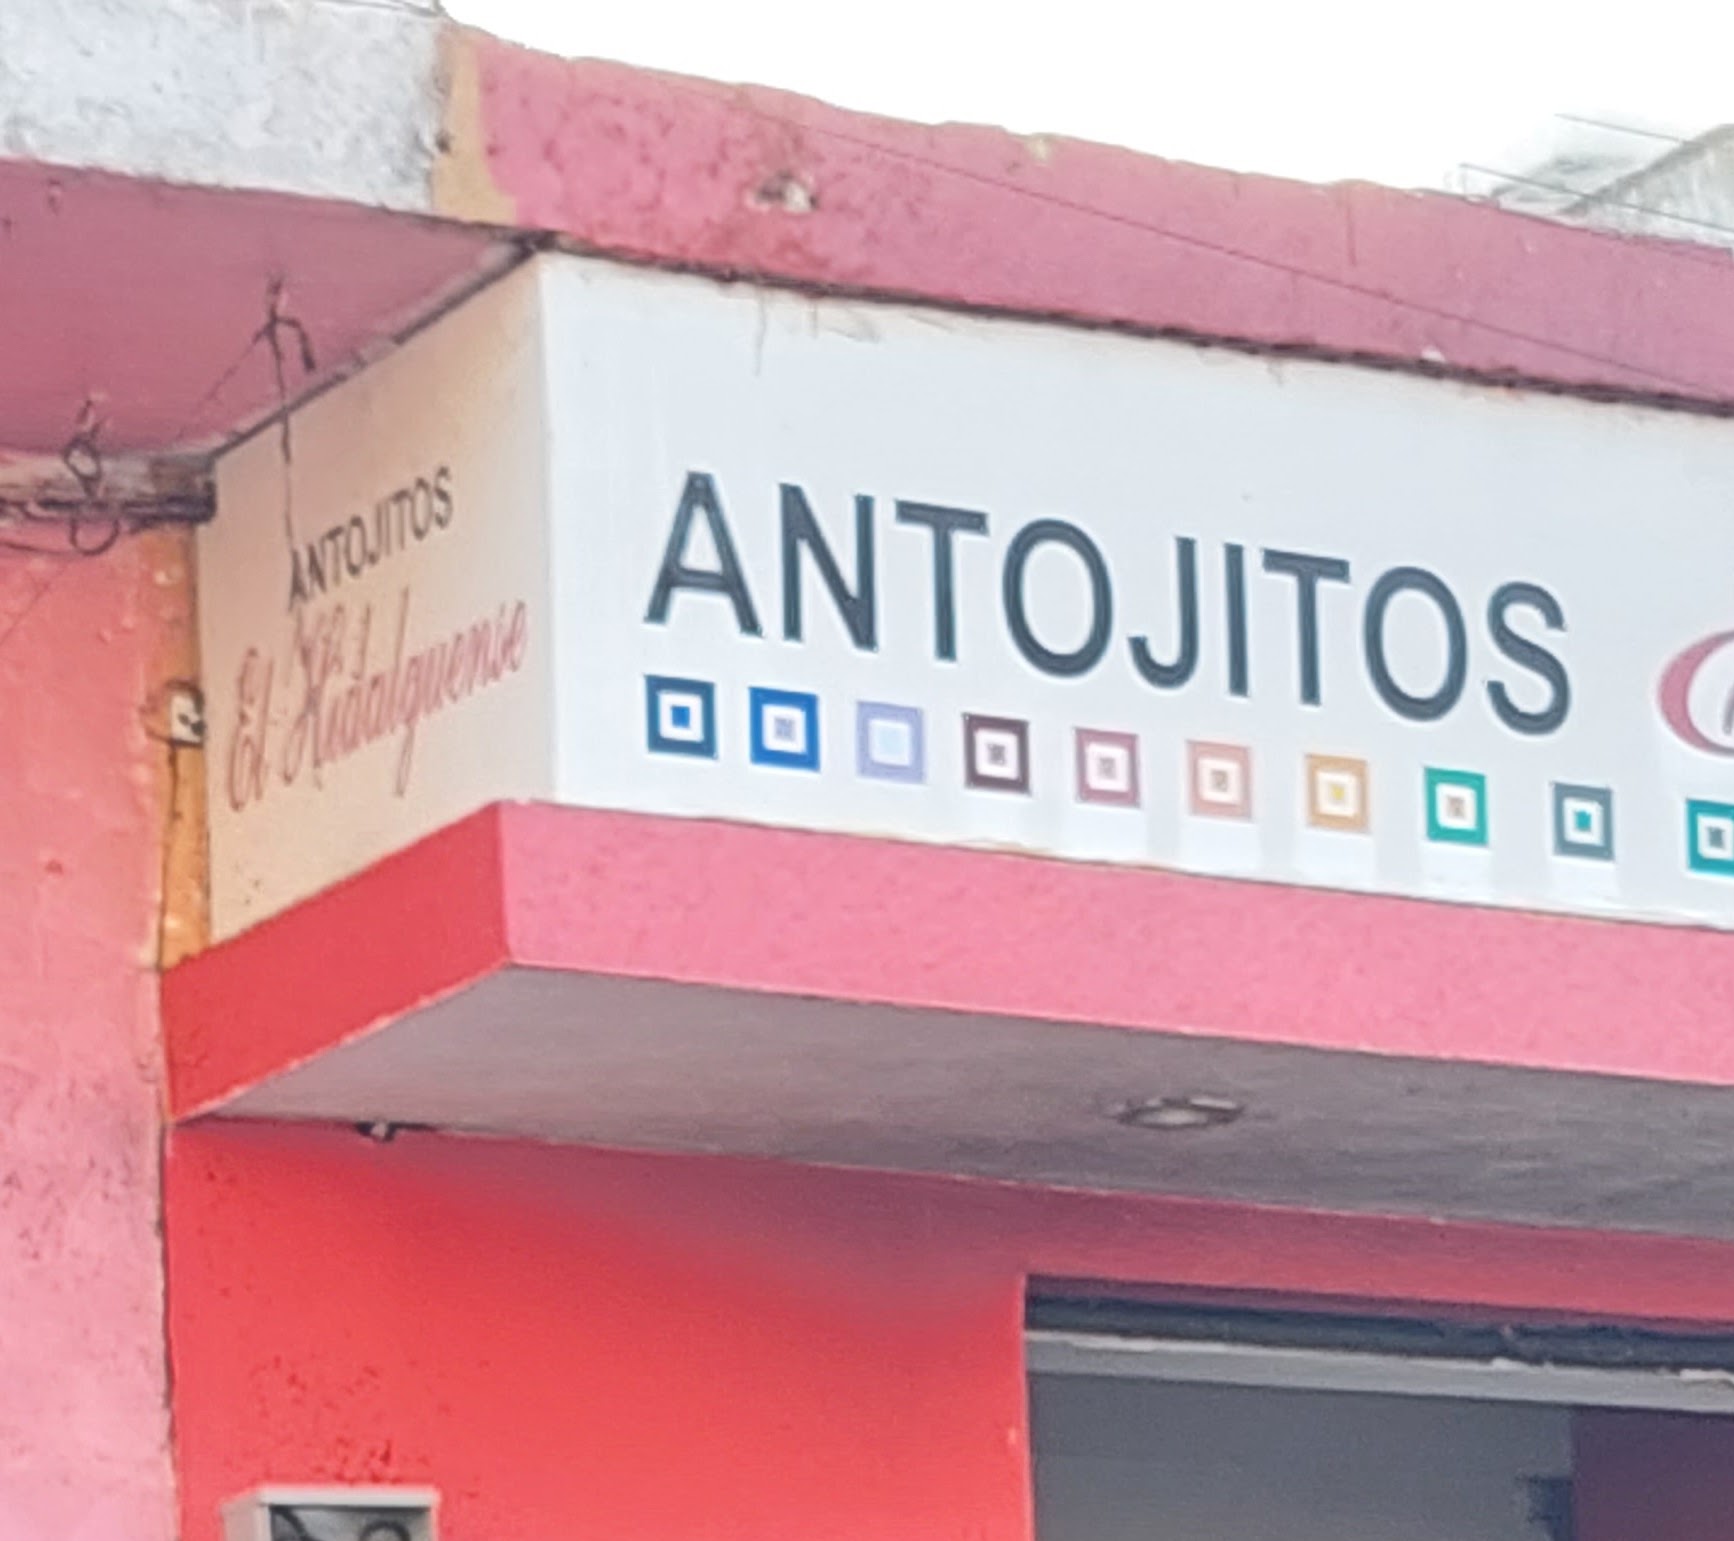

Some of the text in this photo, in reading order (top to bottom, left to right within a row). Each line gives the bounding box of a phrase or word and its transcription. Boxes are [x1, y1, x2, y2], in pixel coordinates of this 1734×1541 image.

[287, 466, 454, 612] ANTOJITOS
[643, 470, 1572, 736] ANTOJITOS
[228, 585, 527, 812] El Hidalguense
